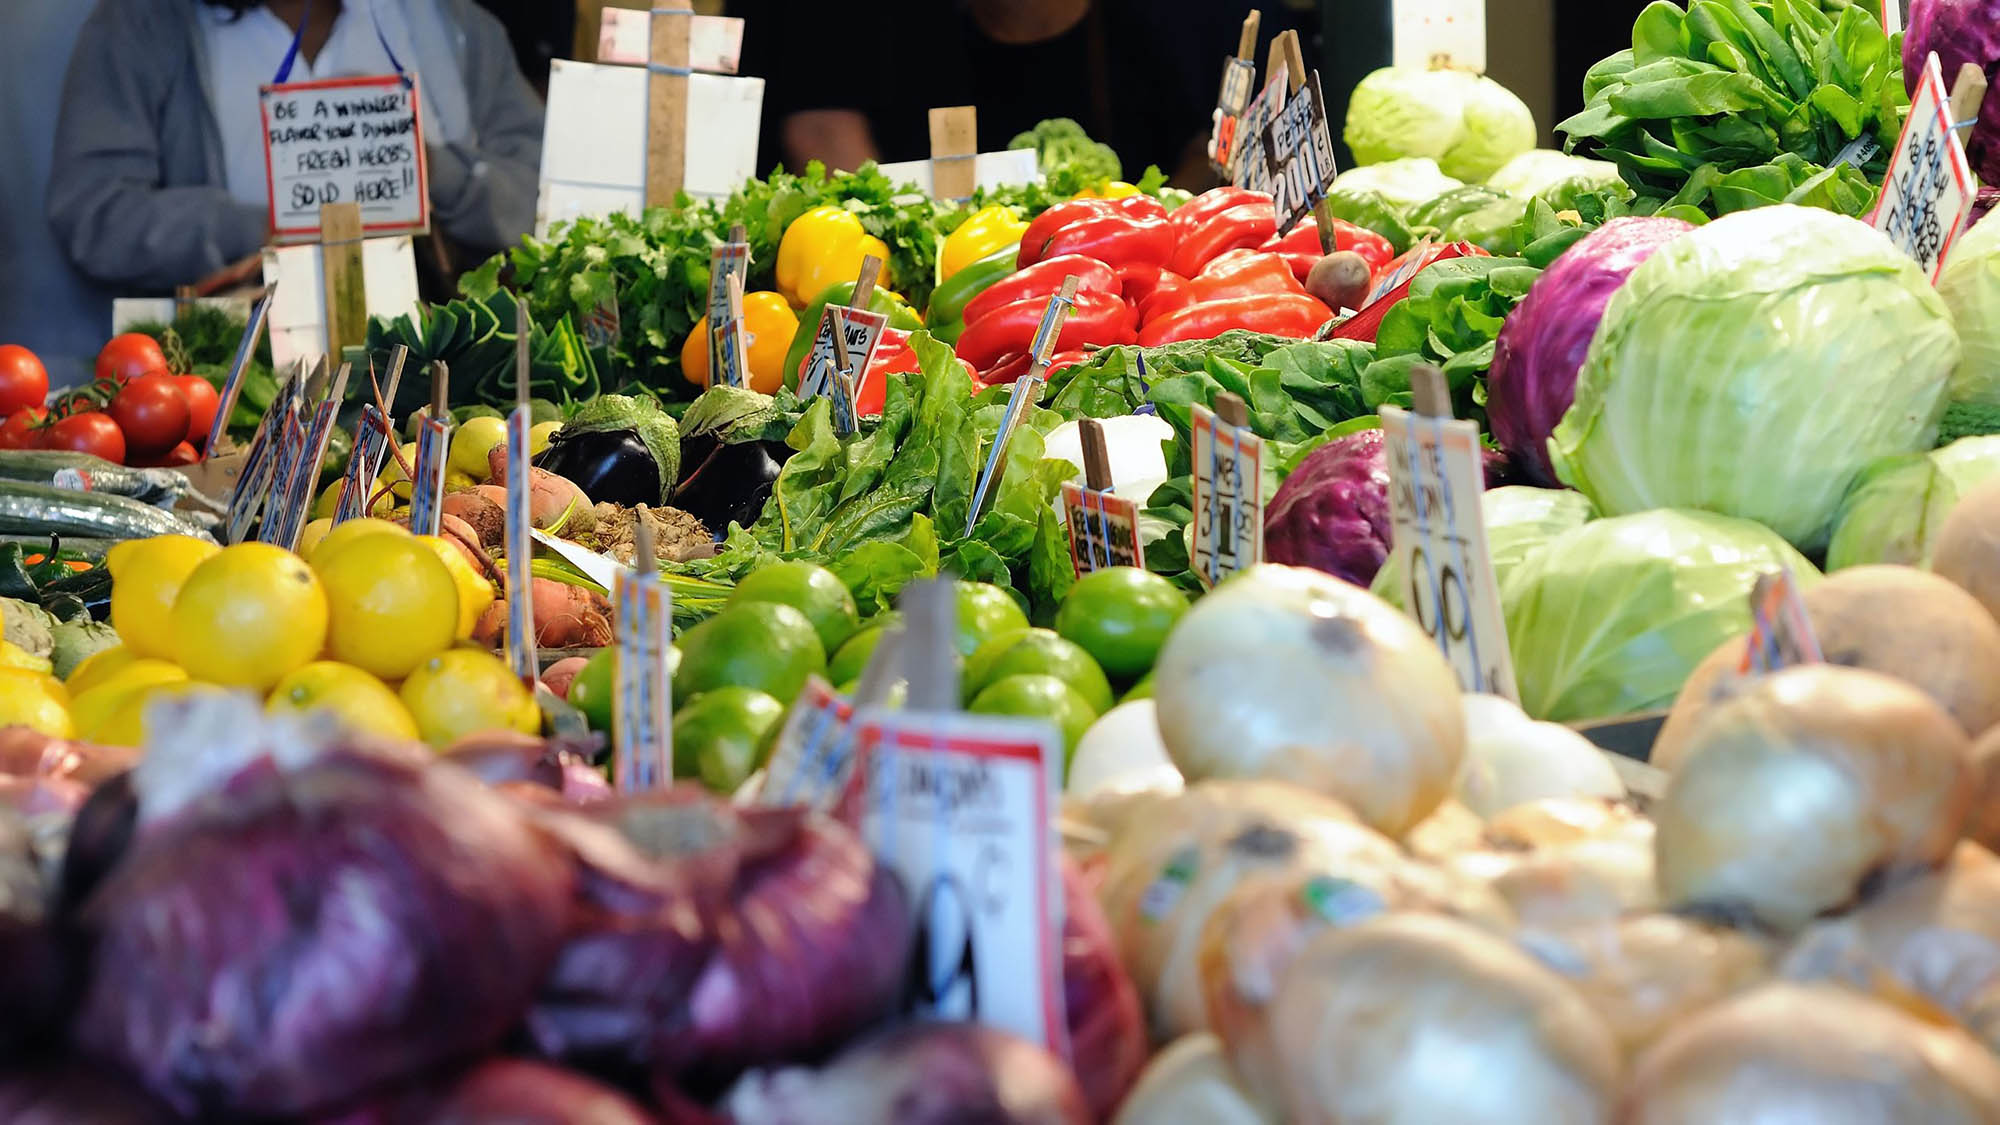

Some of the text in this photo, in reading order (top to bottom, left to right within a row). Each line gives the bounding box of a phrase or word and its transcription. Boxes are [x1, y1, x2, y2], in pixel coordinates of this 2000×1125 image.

[274, 100, 298, 119] BE
[314, 100, 328, 118] A
[297, 143, 411, 172] FRESH HERBS
[291, 182, 340, 210] SOLD
[1272, 141, 1319, 232] 200
